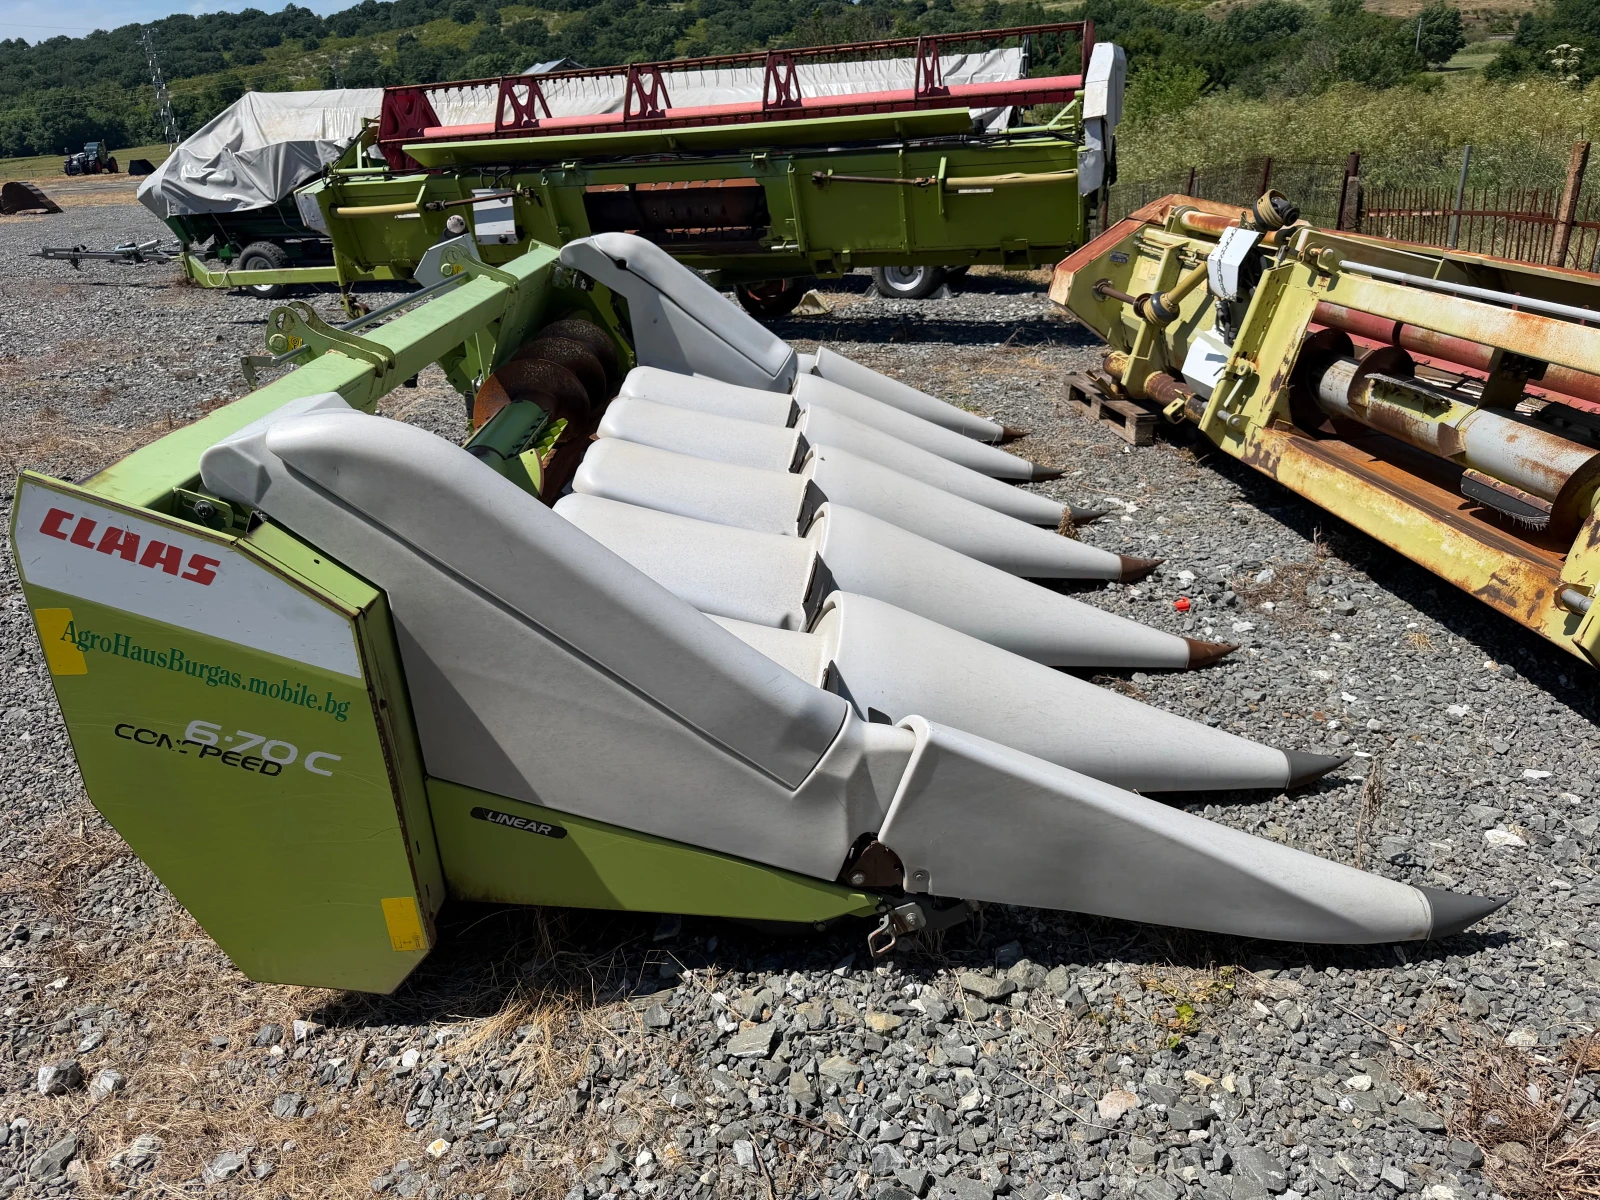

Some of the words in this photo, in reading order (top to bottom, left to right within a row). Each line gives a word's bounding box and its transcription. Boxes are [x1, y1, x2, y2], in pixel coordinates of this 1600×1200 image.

[39, 507, 221, 586] CLAAS
[304, 751, 342, 777] C
[487, 811, 552, 835] LINEAR
